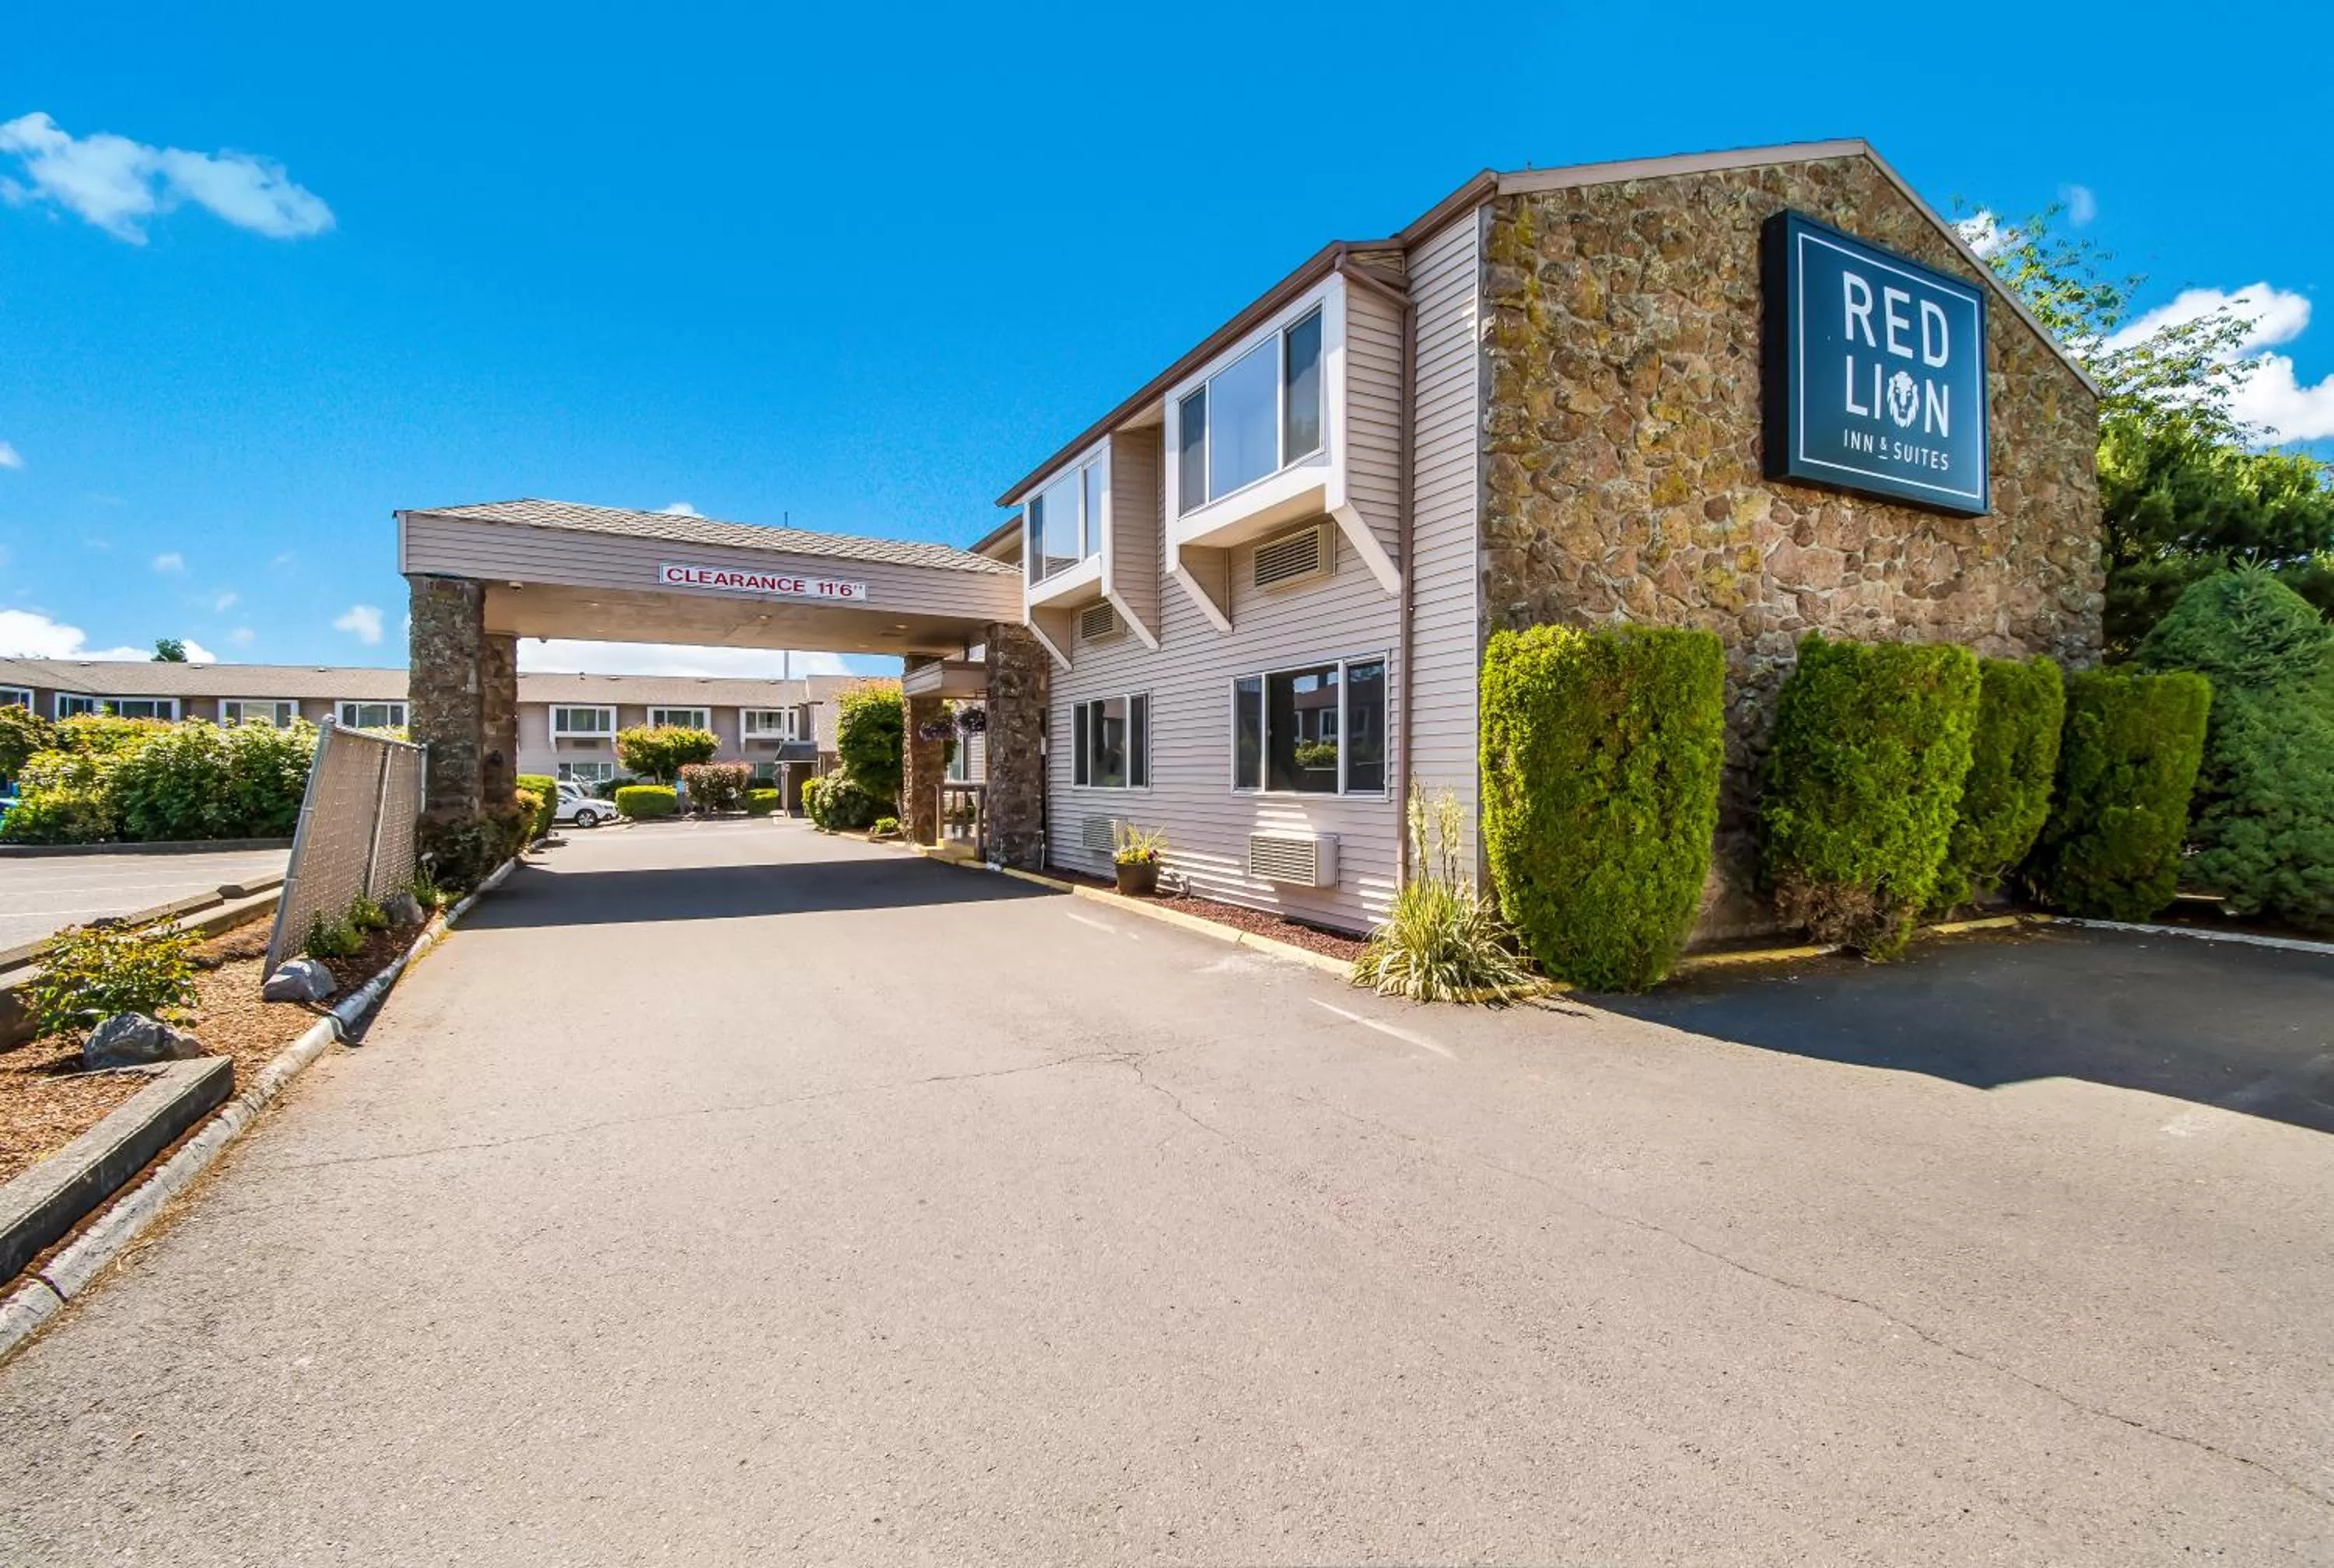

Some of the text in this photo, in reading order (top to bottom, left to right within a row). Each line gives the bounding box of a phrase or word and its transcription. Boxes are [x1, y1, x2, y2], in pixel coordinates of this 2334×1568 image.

[1843, 271, 1949, 368] RED
[1846, 355, 1949, 438] LION
[1844, 429, 1949, 471] INN & SUITES
[667, 568, 805, 592] CLEARANCE
